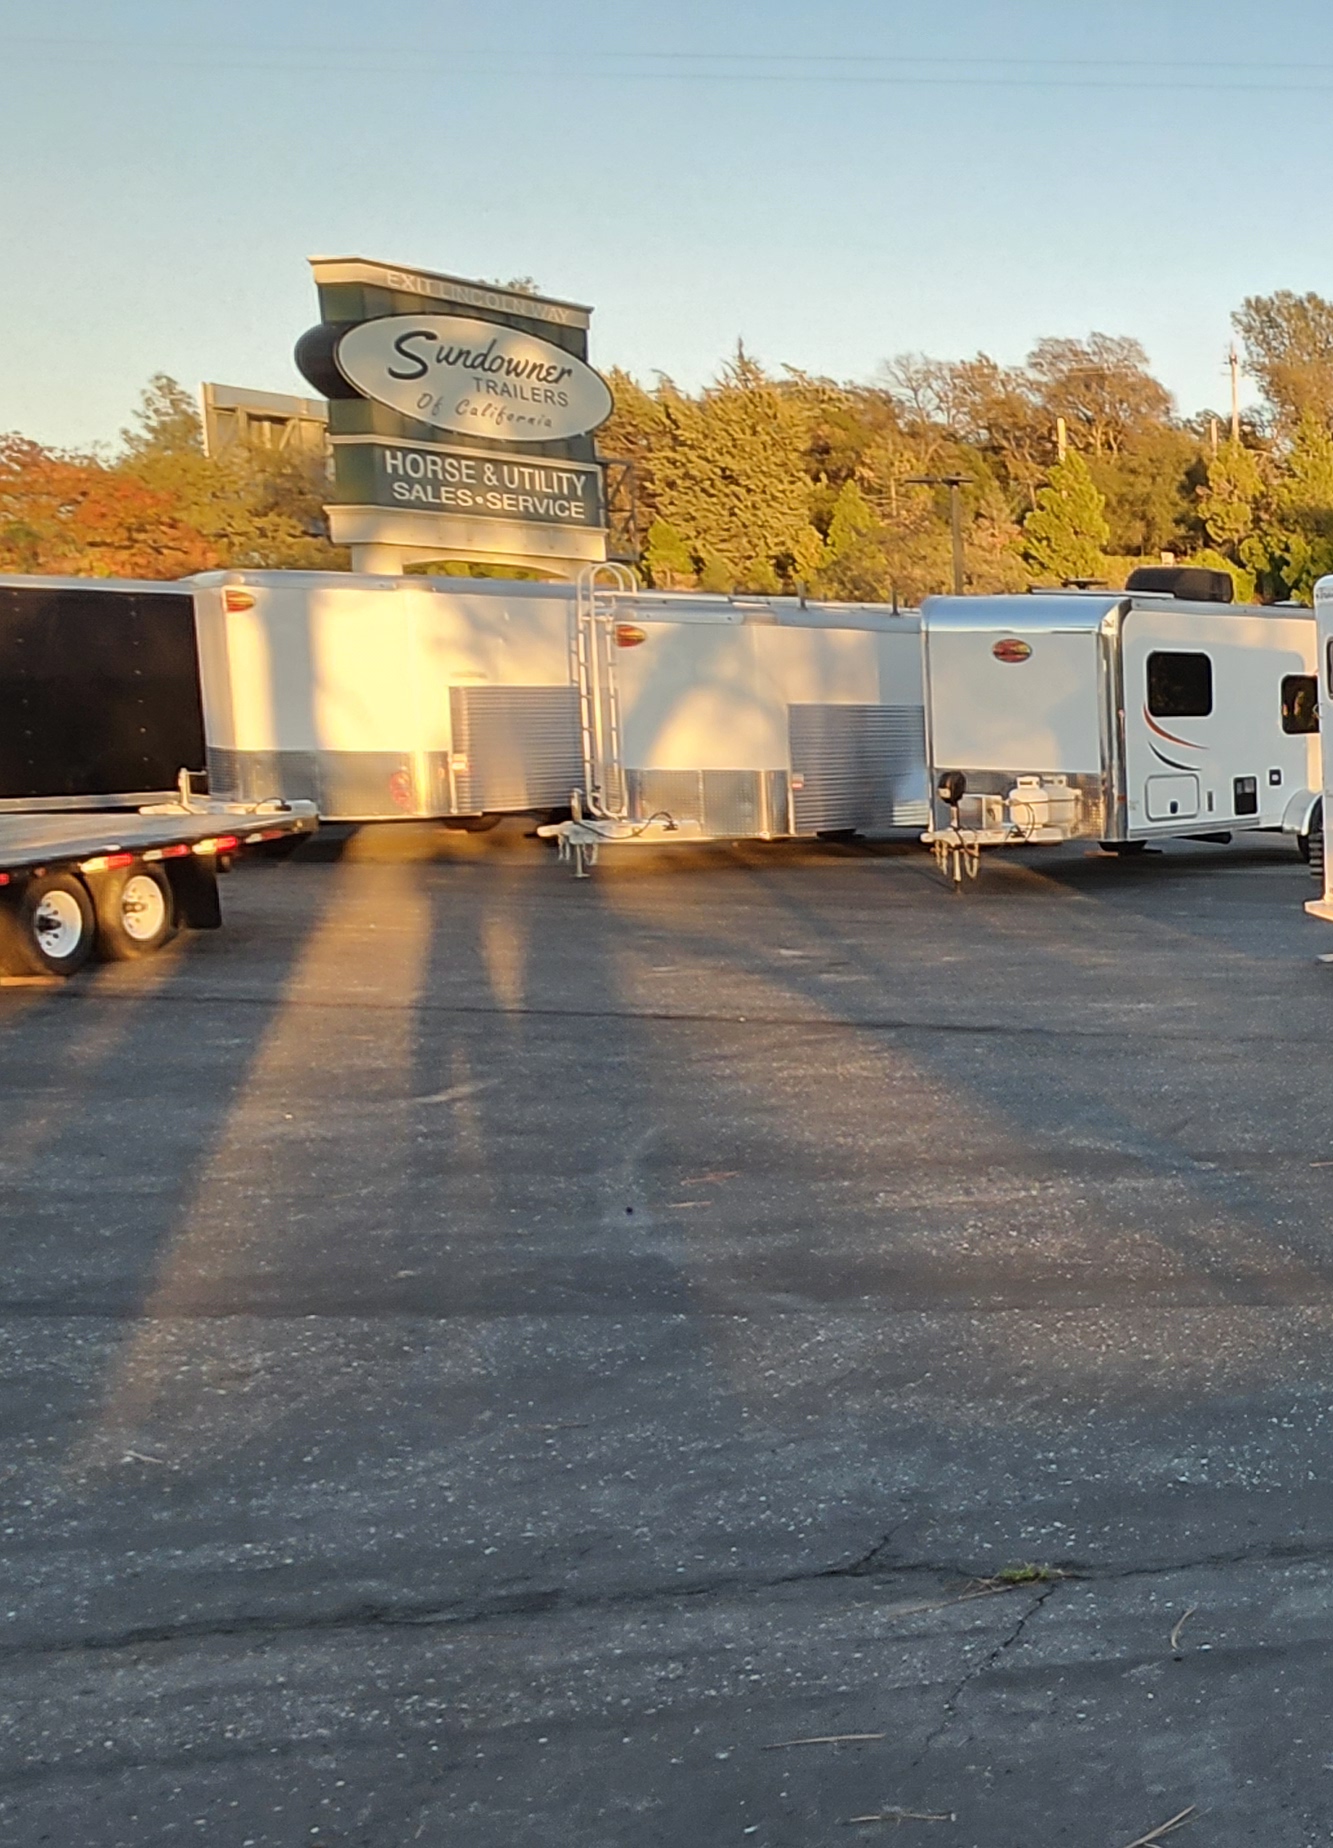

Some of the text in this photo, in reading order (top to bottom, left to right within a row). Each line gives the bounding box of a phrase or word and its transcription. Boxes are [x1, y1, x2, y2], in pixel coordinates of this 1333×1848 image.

[387, 272, 570, 323] EXIT LINCOLN WAY
[387, 330, 573, 384] Sundowner
[416, 392, 553, 428] Of California
[472, 376, 569, 408] TRAILERS
[384, 449, 586, 498] HORSE & UTILITY
